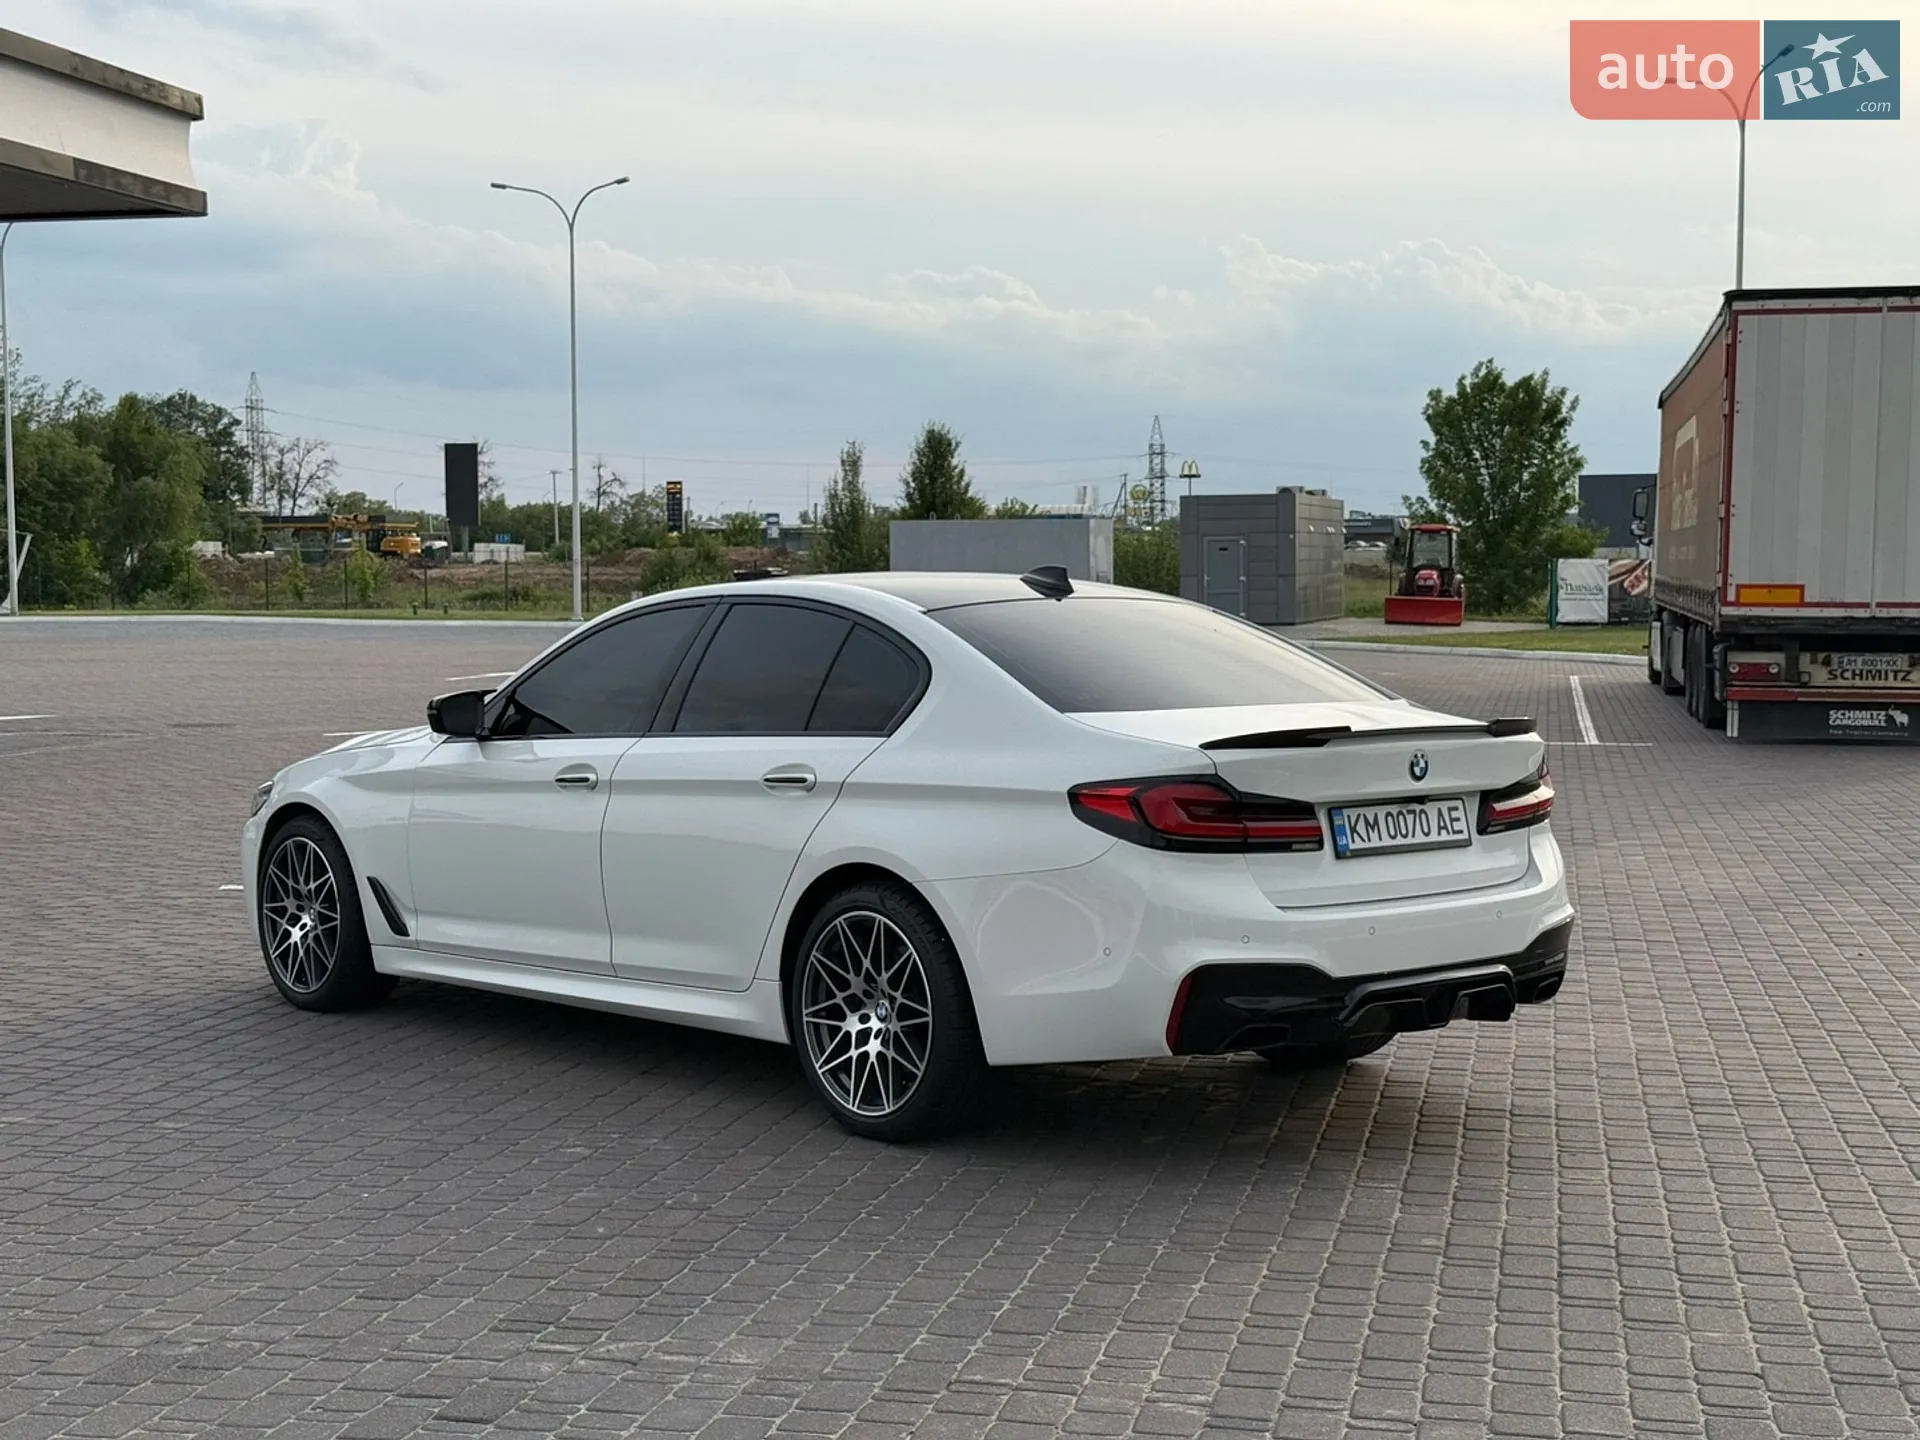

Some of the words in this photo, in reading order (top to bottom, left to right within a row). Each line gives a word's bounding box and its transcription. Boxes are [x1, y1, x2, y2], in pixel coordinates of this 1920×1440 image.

[1827, 668, 1913, 682] SCHMITZ
[1828, 709, 1887, 720] SCHMITZ
[1347, 812, 1383, 844] KM
[1385, 807, 1431, 840] 0070
[1437, 805, 1464, 837] AE
